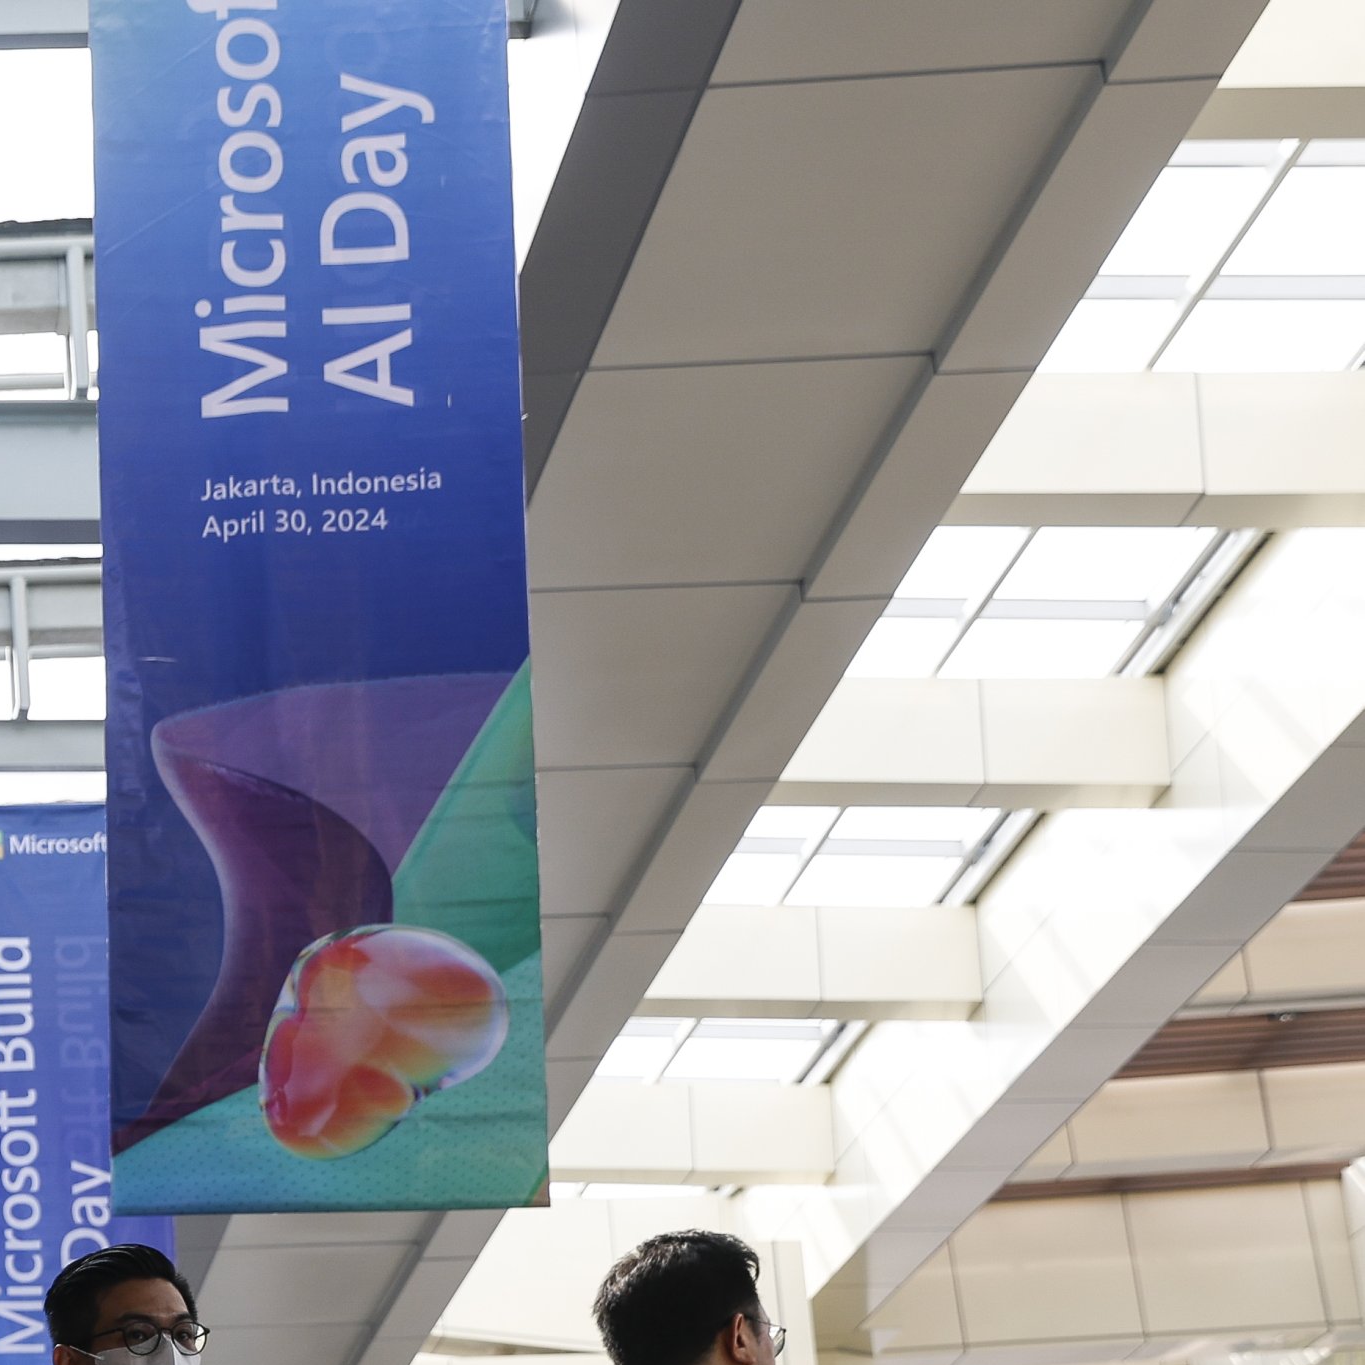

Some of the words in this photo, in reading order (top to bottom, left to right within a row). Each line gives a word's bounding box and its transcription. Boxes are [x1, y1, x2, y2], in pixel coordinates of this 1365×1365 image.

[320, 73, 434, 265] Day
[186, 0, 289, 418] Microsof
[322, 304, 414, 406] AI
[200, 474, 302, 501] Jakarta,
[312, 467, 442, 495] Indonesia
[202, 509, 265, 543] April
[275, 509, 312, 536] 30,
[322, 507, 388, 533] 2024
[10, 832, 106, 854] Microsoft
